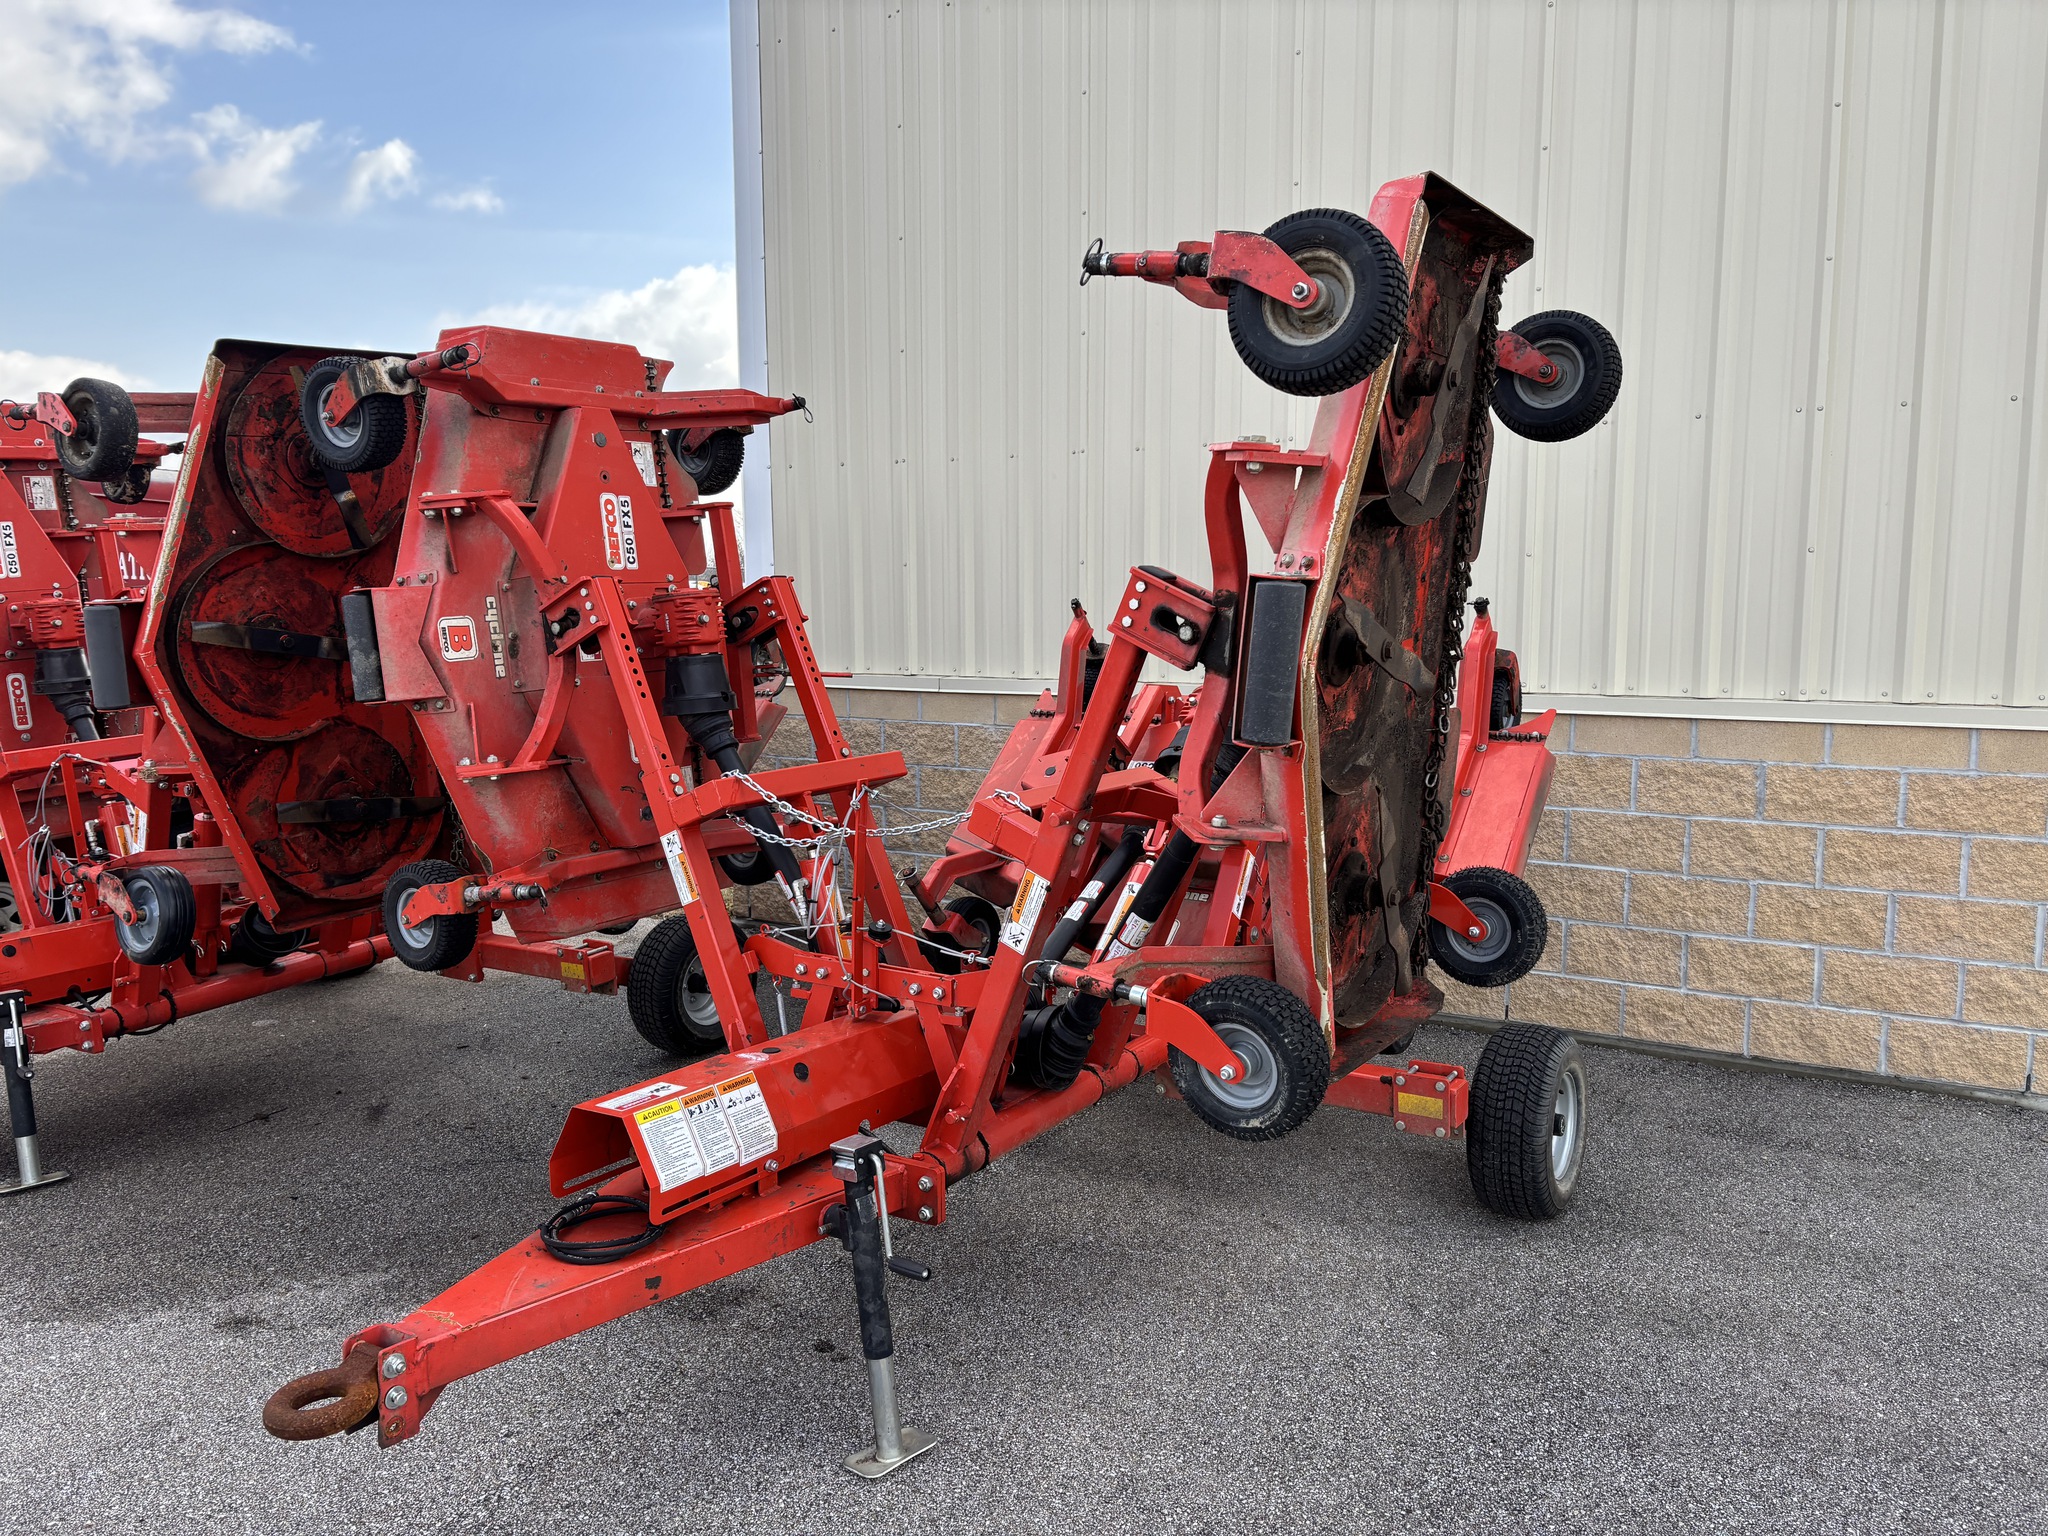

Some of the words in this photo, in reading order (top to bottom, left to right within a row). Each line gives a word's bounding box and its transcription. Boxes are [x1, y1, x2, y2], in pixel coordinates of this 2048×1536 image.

[620, 499, 632, 529] FX5
[2, 524, 15, 547] FX5
[603, 498, 621, 565] BEFCO
[7, 552, 18, 574] C50
[625, 537, 636, 565] C50
[441, 626, 450, 653] BEFCO
[447, 625, 473, 653] B
[484, 596, 506, 678] cyclone
[10, 677, 29, 726] BEFCO
[1017, 879, 1031, 908] WARNING
[727, 1075, 752, 1090] WARNING
[689, 1089, 715, 1105] WARNING
[646, 1104, 674, 1119] CAUTION
